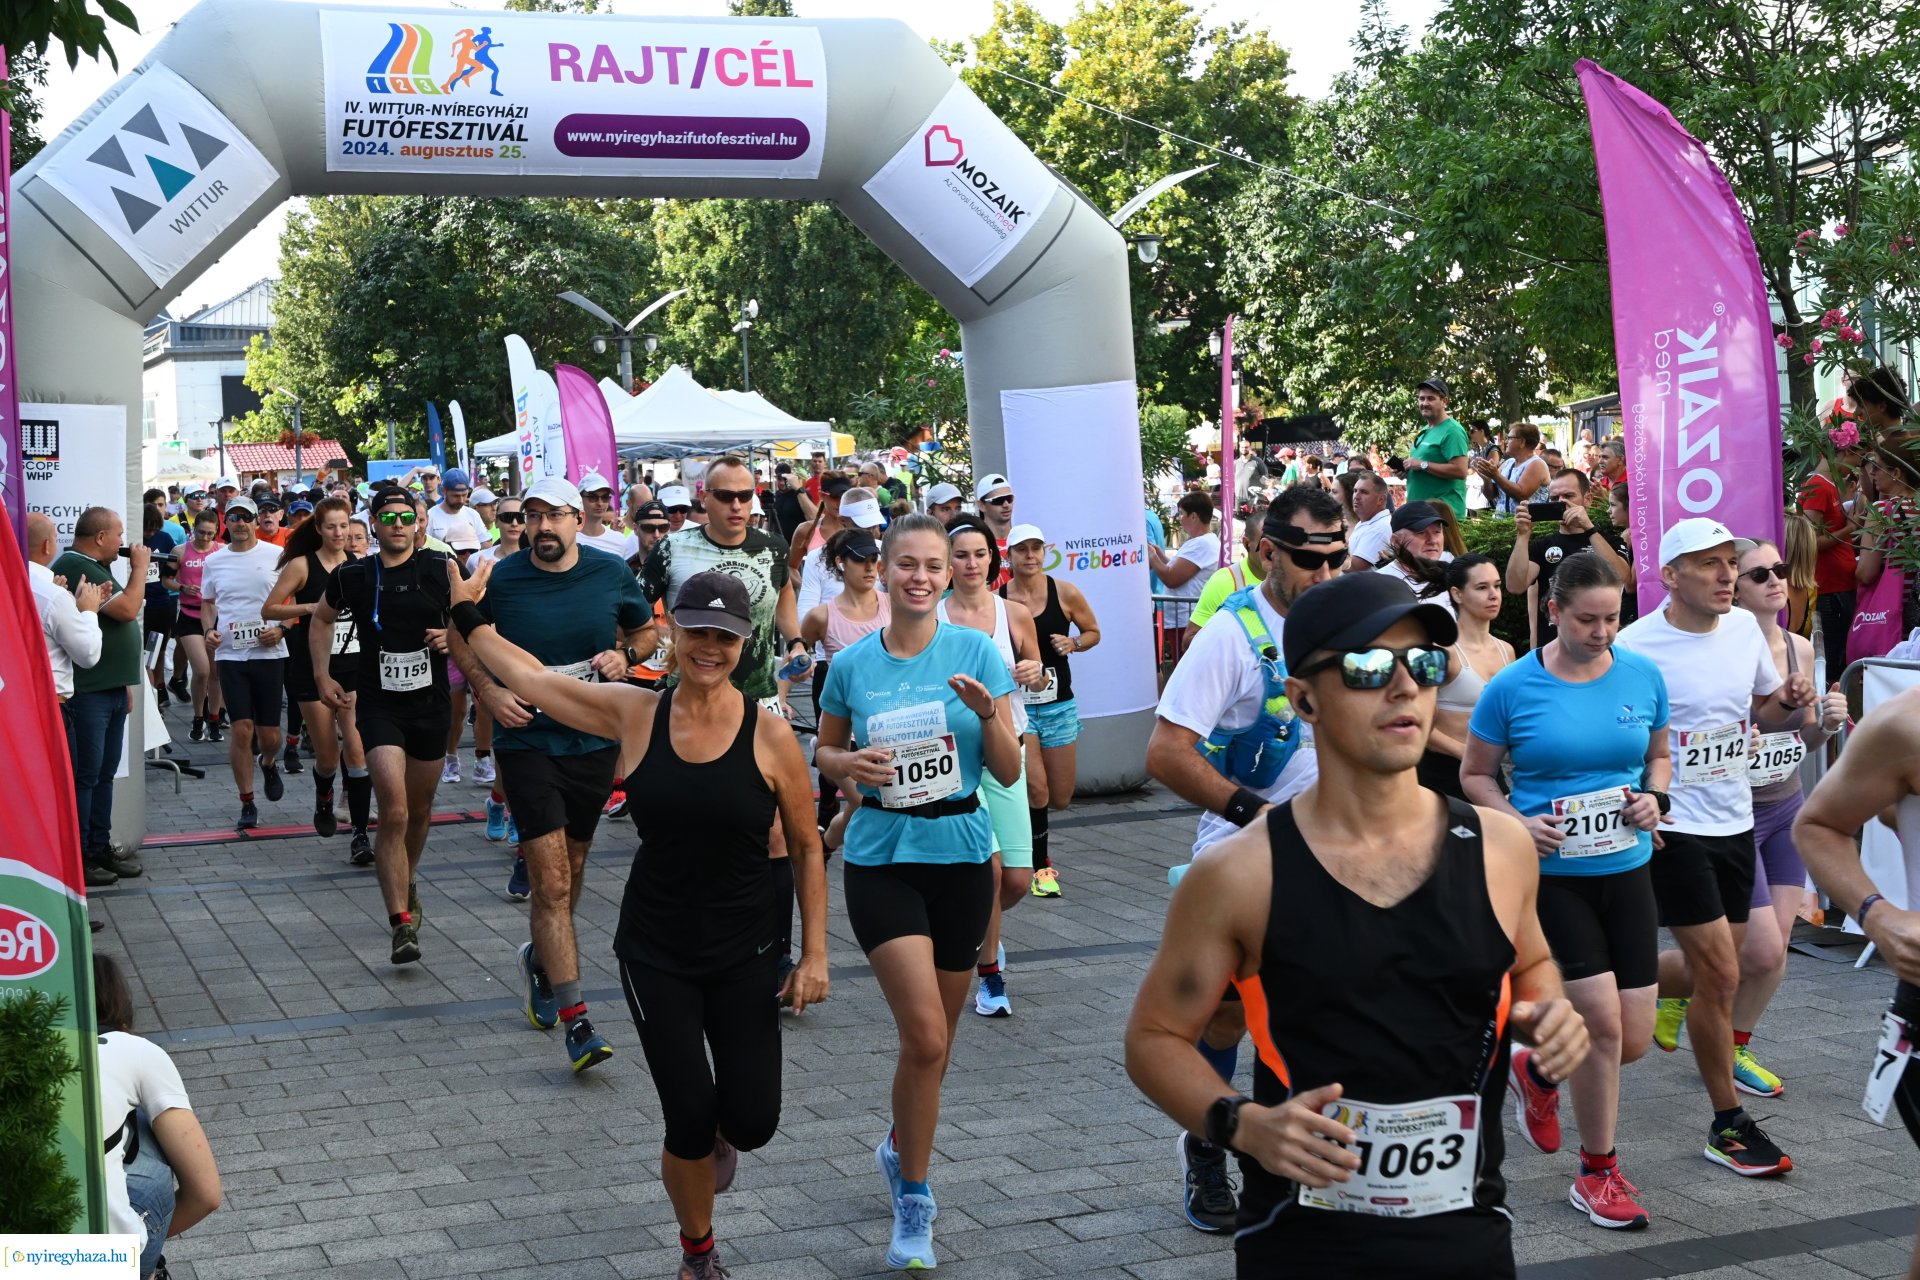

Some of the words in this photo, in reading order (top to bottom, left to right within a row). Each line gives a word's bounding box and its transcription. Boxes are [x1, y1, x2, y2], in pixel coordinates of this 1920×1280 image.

[548, 40, 814, 89] RAJT/CÉL
[373, 78, 381, 91] 1
[395, 78, 409, 91] 2
[420, 79, 432, 92] 3
[345, 101, 363, 114] IV.
[369, 101, 529, 119] WITTUR-NYÍREGYHÁZI
[342, 115, 529, 142] FUTÓFESZTIVÁL
[567, 129, 797, 147] www.nyiregyhazifutofesztival.hu
[342, 141, 394, 156] 2024.
[400, 144, 494, 160] augusztus
[499, 145, 526, 159] 25.
[956, 157, 1026, 225] MOZAIK
[169, 179, 229, 235] WITTUR
[994, 212, 1016, 232] med
[26, 471, 53, 481] WHP
[1065, 533, 1133, 550] NYÍREGYHÁZA
[1066, 549, 1127, 571] Többet
[384, 661, 428, 679] 21159
[1686, 738, 1744, 766] 21142
[1750, 745, 1802, 770] 21055
[1325, 1133, 1465, 1179] 1063
